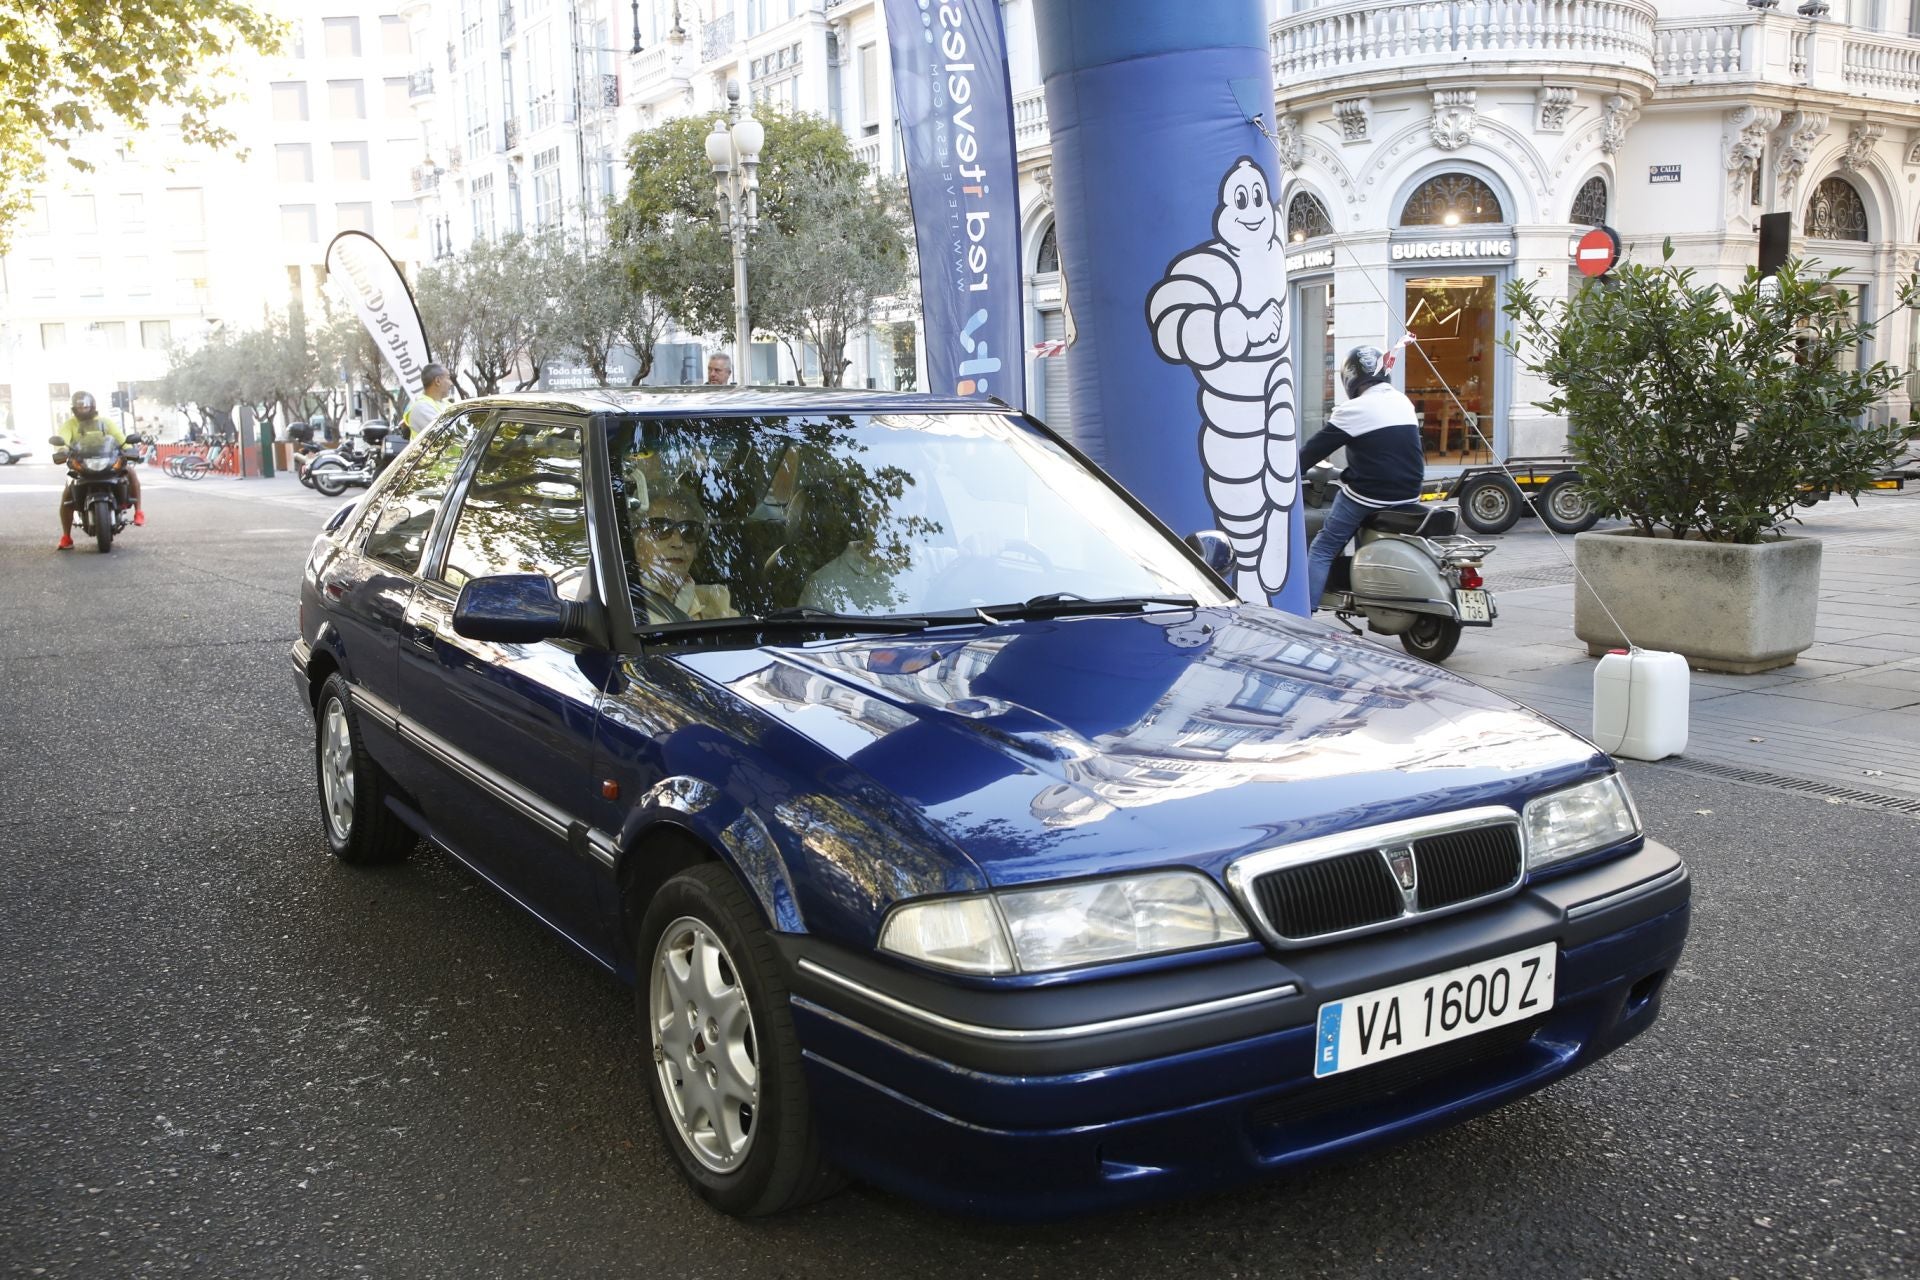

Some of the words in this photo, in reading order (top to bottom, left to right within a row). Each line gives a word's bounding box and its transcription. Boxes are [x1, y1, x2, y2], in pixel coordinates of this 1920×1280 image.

[1660, 165, 1681, 173] CALLE
[1391, 242, 1464, 260] BURGER
[1464, 240, 1511, 257] KING
[1286, 254, 1304, 271] GER
[1305, 250, 1332, 266] KING
[548, 366, 570, 376] Todo
[571, 367, 583, 375] es
[549, 377, 582, 386] cuando
[1465, 605, 1484, 619] 736
[1357, 996, 1402, 1056] VA
[1424, 967, 1510, 1038] 1600
[1518, 957, 1541, 1010] Z
[1323, 1046, 1334, 1063] E
